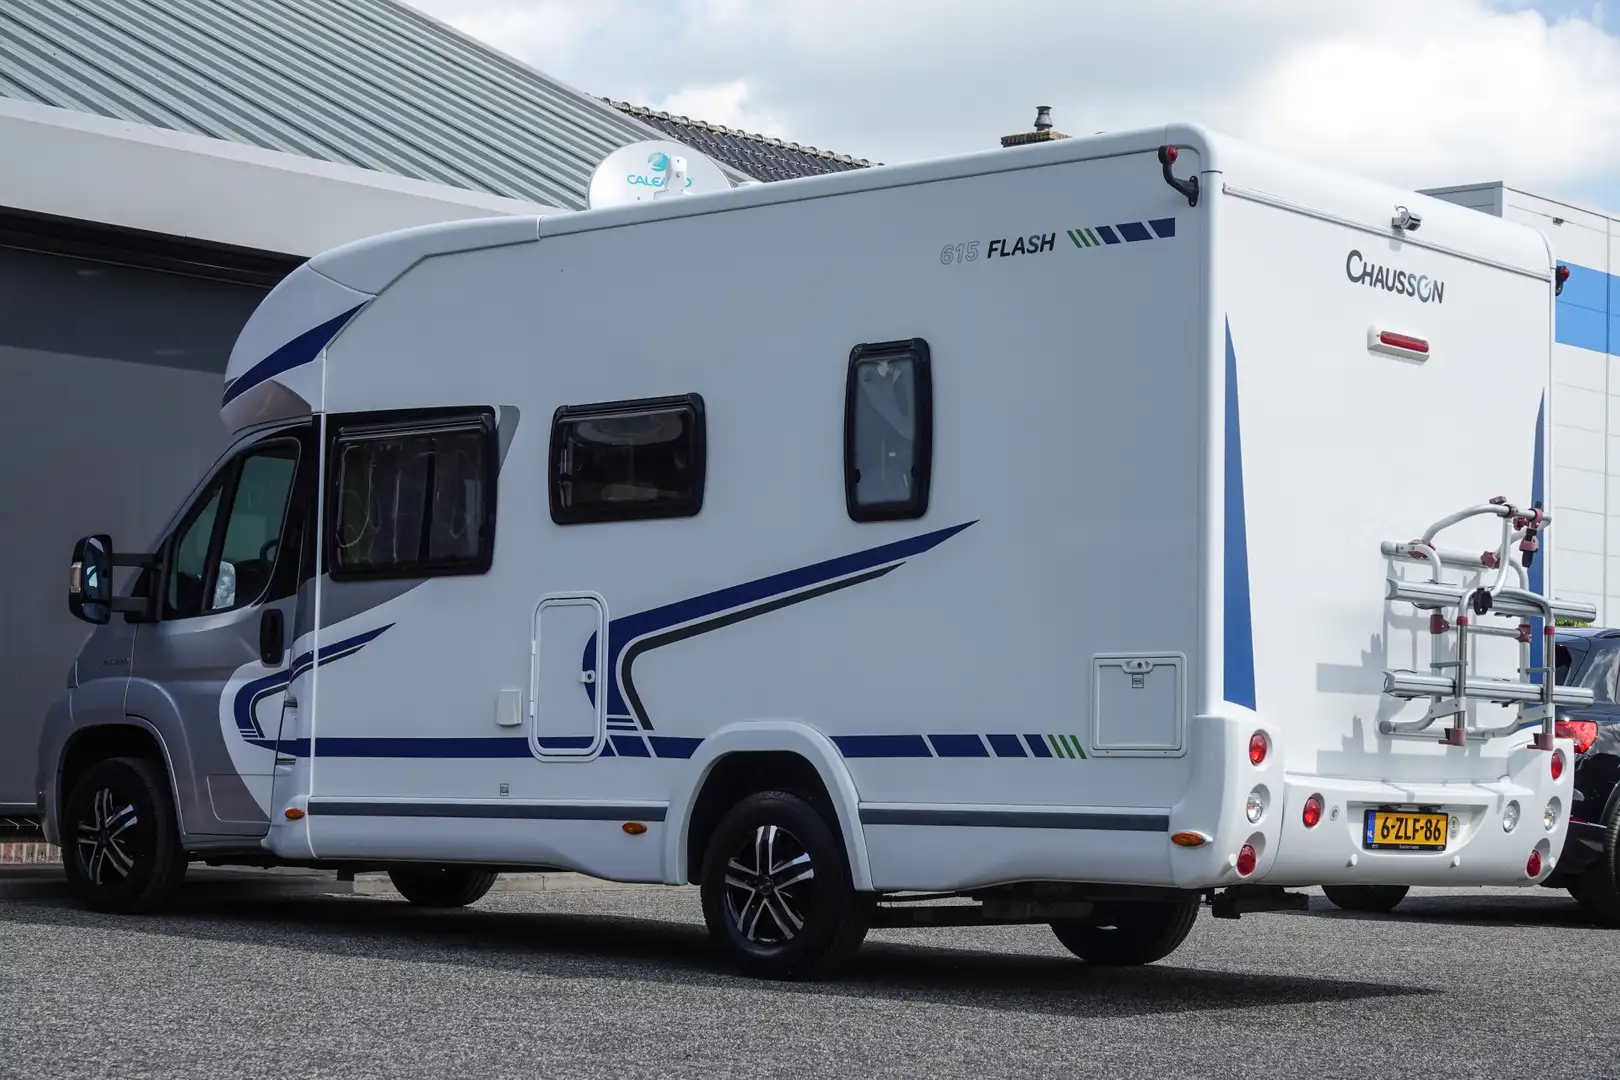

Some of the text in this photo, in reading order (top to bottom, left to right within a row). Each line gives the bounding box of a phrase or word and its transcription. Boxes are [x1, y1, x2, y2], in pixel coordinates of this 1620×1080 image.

[626, 174, 693, 188] CALEO
[940, 231, 1057, 266] 615 FLASH
[1346, 249, 1445, 304] CHAUSSON
[1380, 816, 1442, 842] 6-ZLF-86
